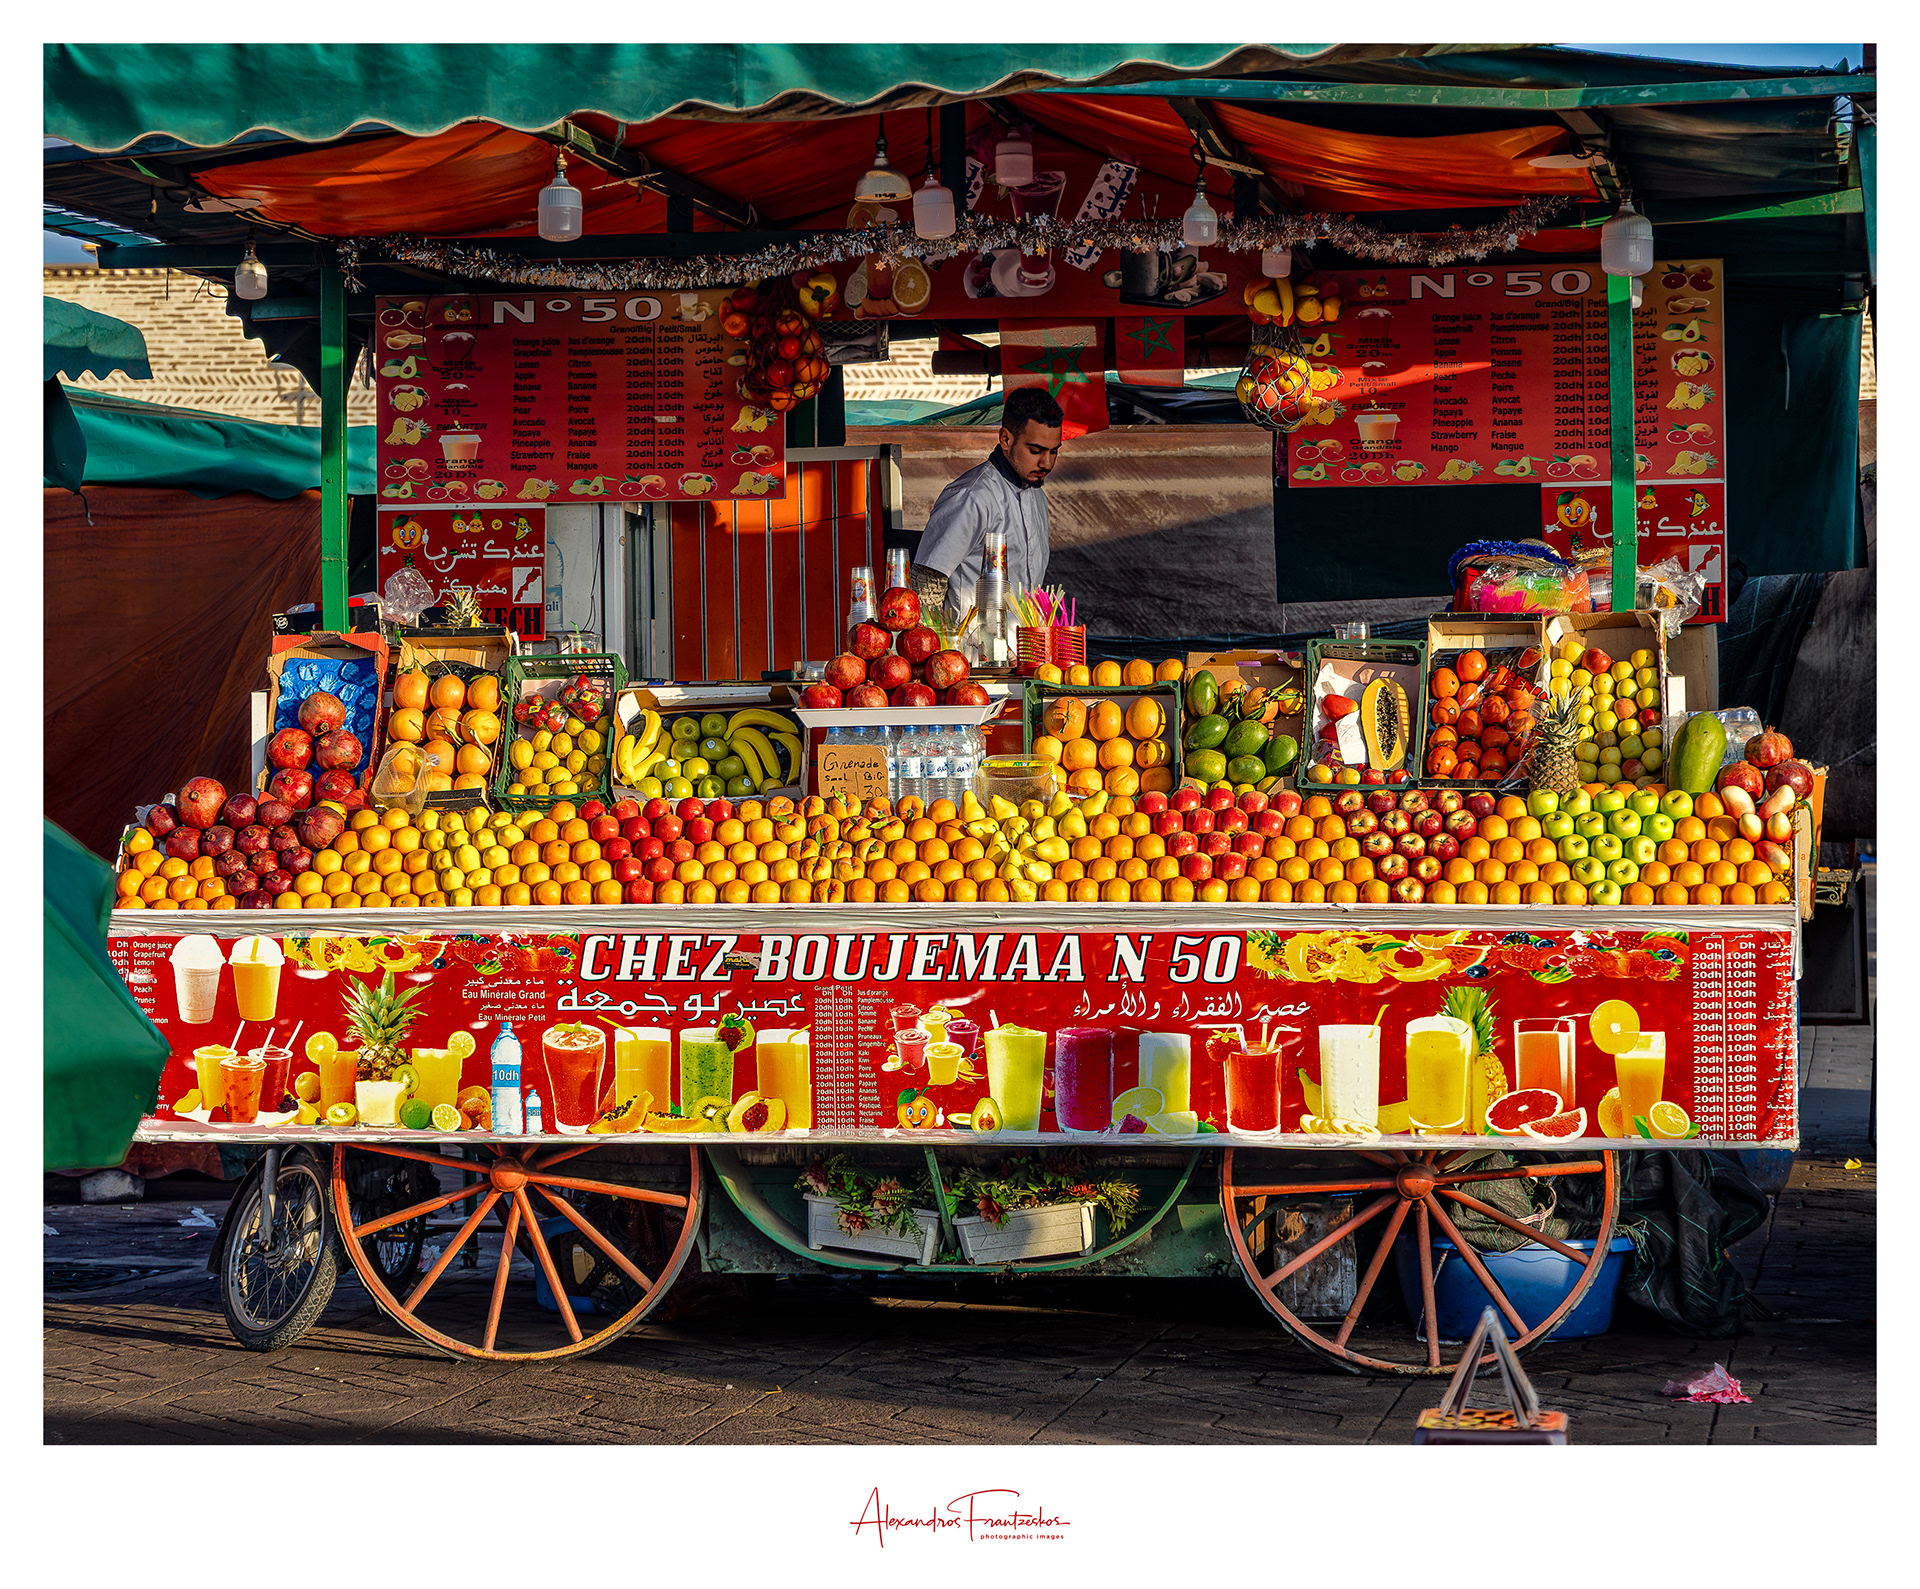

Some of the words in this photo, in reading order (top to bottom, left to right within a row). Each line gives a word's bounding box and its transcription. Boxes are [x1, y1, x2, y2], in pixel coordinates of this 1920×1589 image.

[1347, 299, 1406, 307] EMPORTER
[1535, 299, 1580, 308] Grand/Big
[1432, 314, 1460, 323] Orange
[1462, 313, 1482, 323] juice
[1490, 312, 1503, 320] Jus
[1505, 312, 1540, 321] d'orange
[434, 323, 489, 332] EMPORTER
[610, 325, 652, 334] Grand/Big
[659, 324, 701, 333] Petit/Small
[1433, 324, 1473, 335] Grapefruit
[1490, 323, 1550, 333] Pamplemousse
[513, 338, 540, 347] Orange
[541, 337, 560, 347] juice
[568, 337, 580, 345] Jus
[582, 336, 615, 346] d'orange
[657, 335, 683, 343] 10dh
[1434, 337, 1460, 345] Lemon
[1491, 336, 1516, 344] Citron
[513, 349, 552, 359] Grapefruit
[568, 347, 623, 357] Pamplemousse
[657, 346, 683, 354] 10dh
[1356, 349, 1380, 357] 20
[1434, 348, 1456, 358] Apple
[1491, 348, 1522, 356] Pomme
[568, 359, 591, 367] Citron
[1433, 360, 1463, 368] Banana
[1491, 359, 1522, 367] Banane
[514, 371, 535, 381] Apple
[568, 371, 597, 379] Pomme
[703, 367, 722, 379] تفاح
[1433, 373, 1458, 381] Peach
[1491, 371, 1516, 379] Peche
[514, 383, 541, 391] Banana
[568, 382, 597, 390] Banane
[708, 378, 723, 388] موز
[1434, 385, 1452, 393] Pear
[1492, 383, 1513, 391] Poire
[514, 395, 535, 403] Peach
[568, 394, 591, 402] Peche
[1433, 396, 1468, 405] Avocado
[1492, 395, 1520, 404] Avocat
[569, 405, 588, 413] Poire
[1351, 402, 1406, 410] EMPORTER
[1433, 408, 1463, 418] Papaya
[1493, 407, 1522, 416] Papaye
[512, 418, 545, 426] Avocado
[568, 417, 595, 425] Avocat
[1433, 418, 1473, 428] Pineapple
[1492, 418, 1523, 426] Ananas
[436, 423, 487, 432] EMPORTER
[513, 429, 541, 438] Papaya
[568, 428, 597, 437] Papaye
[1431, 430, 1477, 440] Strawberry
[1492, 430, 1516, 438] Fraise
[512, 439, 550, 448] Pineapple
[568, 439, 597, 447] Ananas
[1431, 444, 1458, 453] Mango
[1491, 443, 1524, 452] Mangue
[511, 451, 554, 460] Strawberry
[567, 451, 590, 459] Fraise
[1349, 452, 1368, 460] 20
[511, 463, 536, 473] Mango
[567, 462, 597, 472] Mangue
[824, 752, 878, 771] Grenade
[133, 941, 155, 950] Orange
[157, 942, 172, 950] juice
[580, 934, 738, 983] CHEZ
[752, 932, 1087, 983] BOUJEMAA
[1105, 933, 1154, 983] N
[1168, 933, 1242, 984] 50
[1727, 970, 1756, 978] 10dh
[1693, 981, 1721, 989] 20dh
[463, 989, 477, 998] Eau
[481, 990, 516, 999] Minérale
[519, 990, 545, 999] Grand
[734, 991, 806, 1021] عصير
[1172, 991, 1242, 1021] الفقراء
[493, 1070, 519, 1080] 10dh
[1694, 1085, 1723, 1093] 30dh
